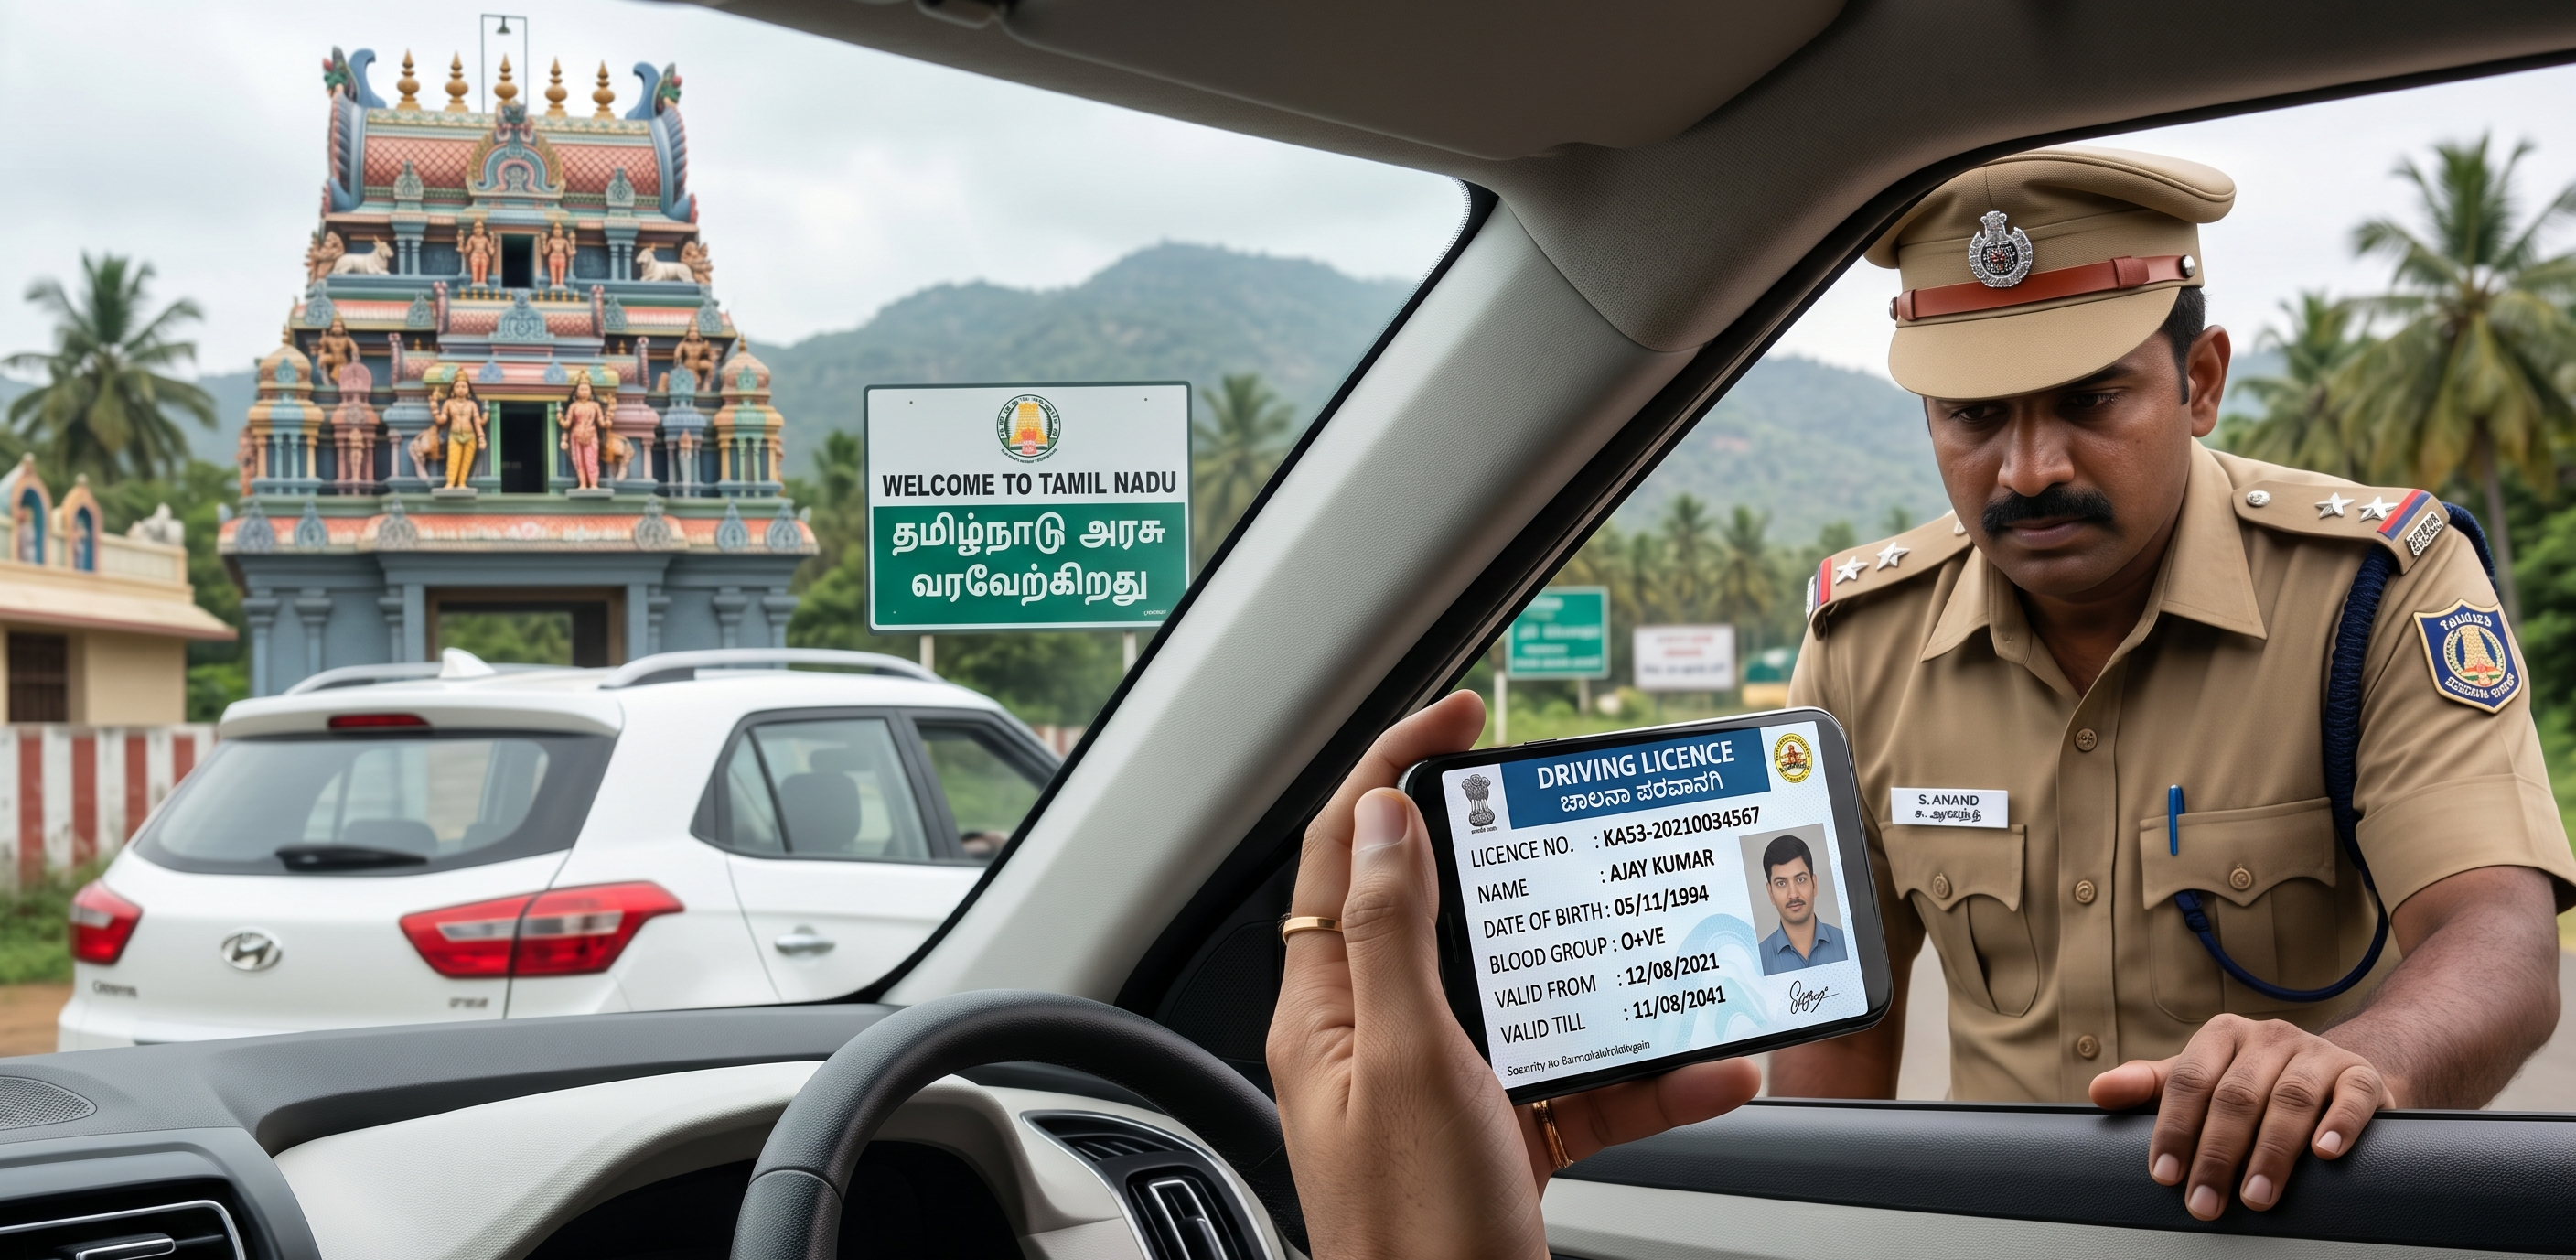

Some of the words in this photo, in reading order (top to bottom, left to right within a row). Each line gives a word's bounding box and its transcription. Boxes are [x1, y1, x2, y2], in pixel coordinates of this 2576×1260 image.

[882, 473, 995, 497] WELCOME
[1002, 472, 1032, 496] TO
[1038, 471, 1108, 495] TAMIL
[1114, 470, 1177, 494] NADU
[892, 511, 1066, 556] தமிழ்நாடு
[1079, 519, 1165, 551] அரசு
[911, 561, 1147, 607] வரவேற்கிறது
[1537, 754, 1637, 790] DRIVING
[1640, 740, 1735, 774] LICENCE
[1560, 787, 1632, 813] ಚಾಲನಾ
[1636, 770, 1724, 802] ಪರವಾನಗಿ
[1917, 793, 1930, 806] S.
[1931, 794, 1980, 806] ANAND
[1470, 840, 1540, 868] LICENCE
[1543, 835, 1574, 856] NO.
[1603, 805, 1760, 847] KA53-20210034567
[1477, 878, 1530, 904] NAME
[1610, 858, 1648, 882] AJAY
[1651, 848, 1715, 876] KUMAR
[1483, 914, 1526, 939] DATE
[1530, 910, 1551, 931] OF
[1555, 901, 1603, 927] BIRTH
[1614, 884, 1710, 918] 05/11/1994
[1489, 948, 1546, 975] BLOOD
[1551, 936, 1607, 963] GROUP
[1621, 926, 1666, 951] O+VE
[1494, 984, 1543, 1008] VALID
[1547, 974, 1596, 1000] FROM
[1626, 952, 1720, 986] 12/08/2021
[1499, 1019, 1550, 1045] VALID
[1551, 1012, 1586, 1035] TILL
[1632, 985, 1726, 1020] 11/08/2041
